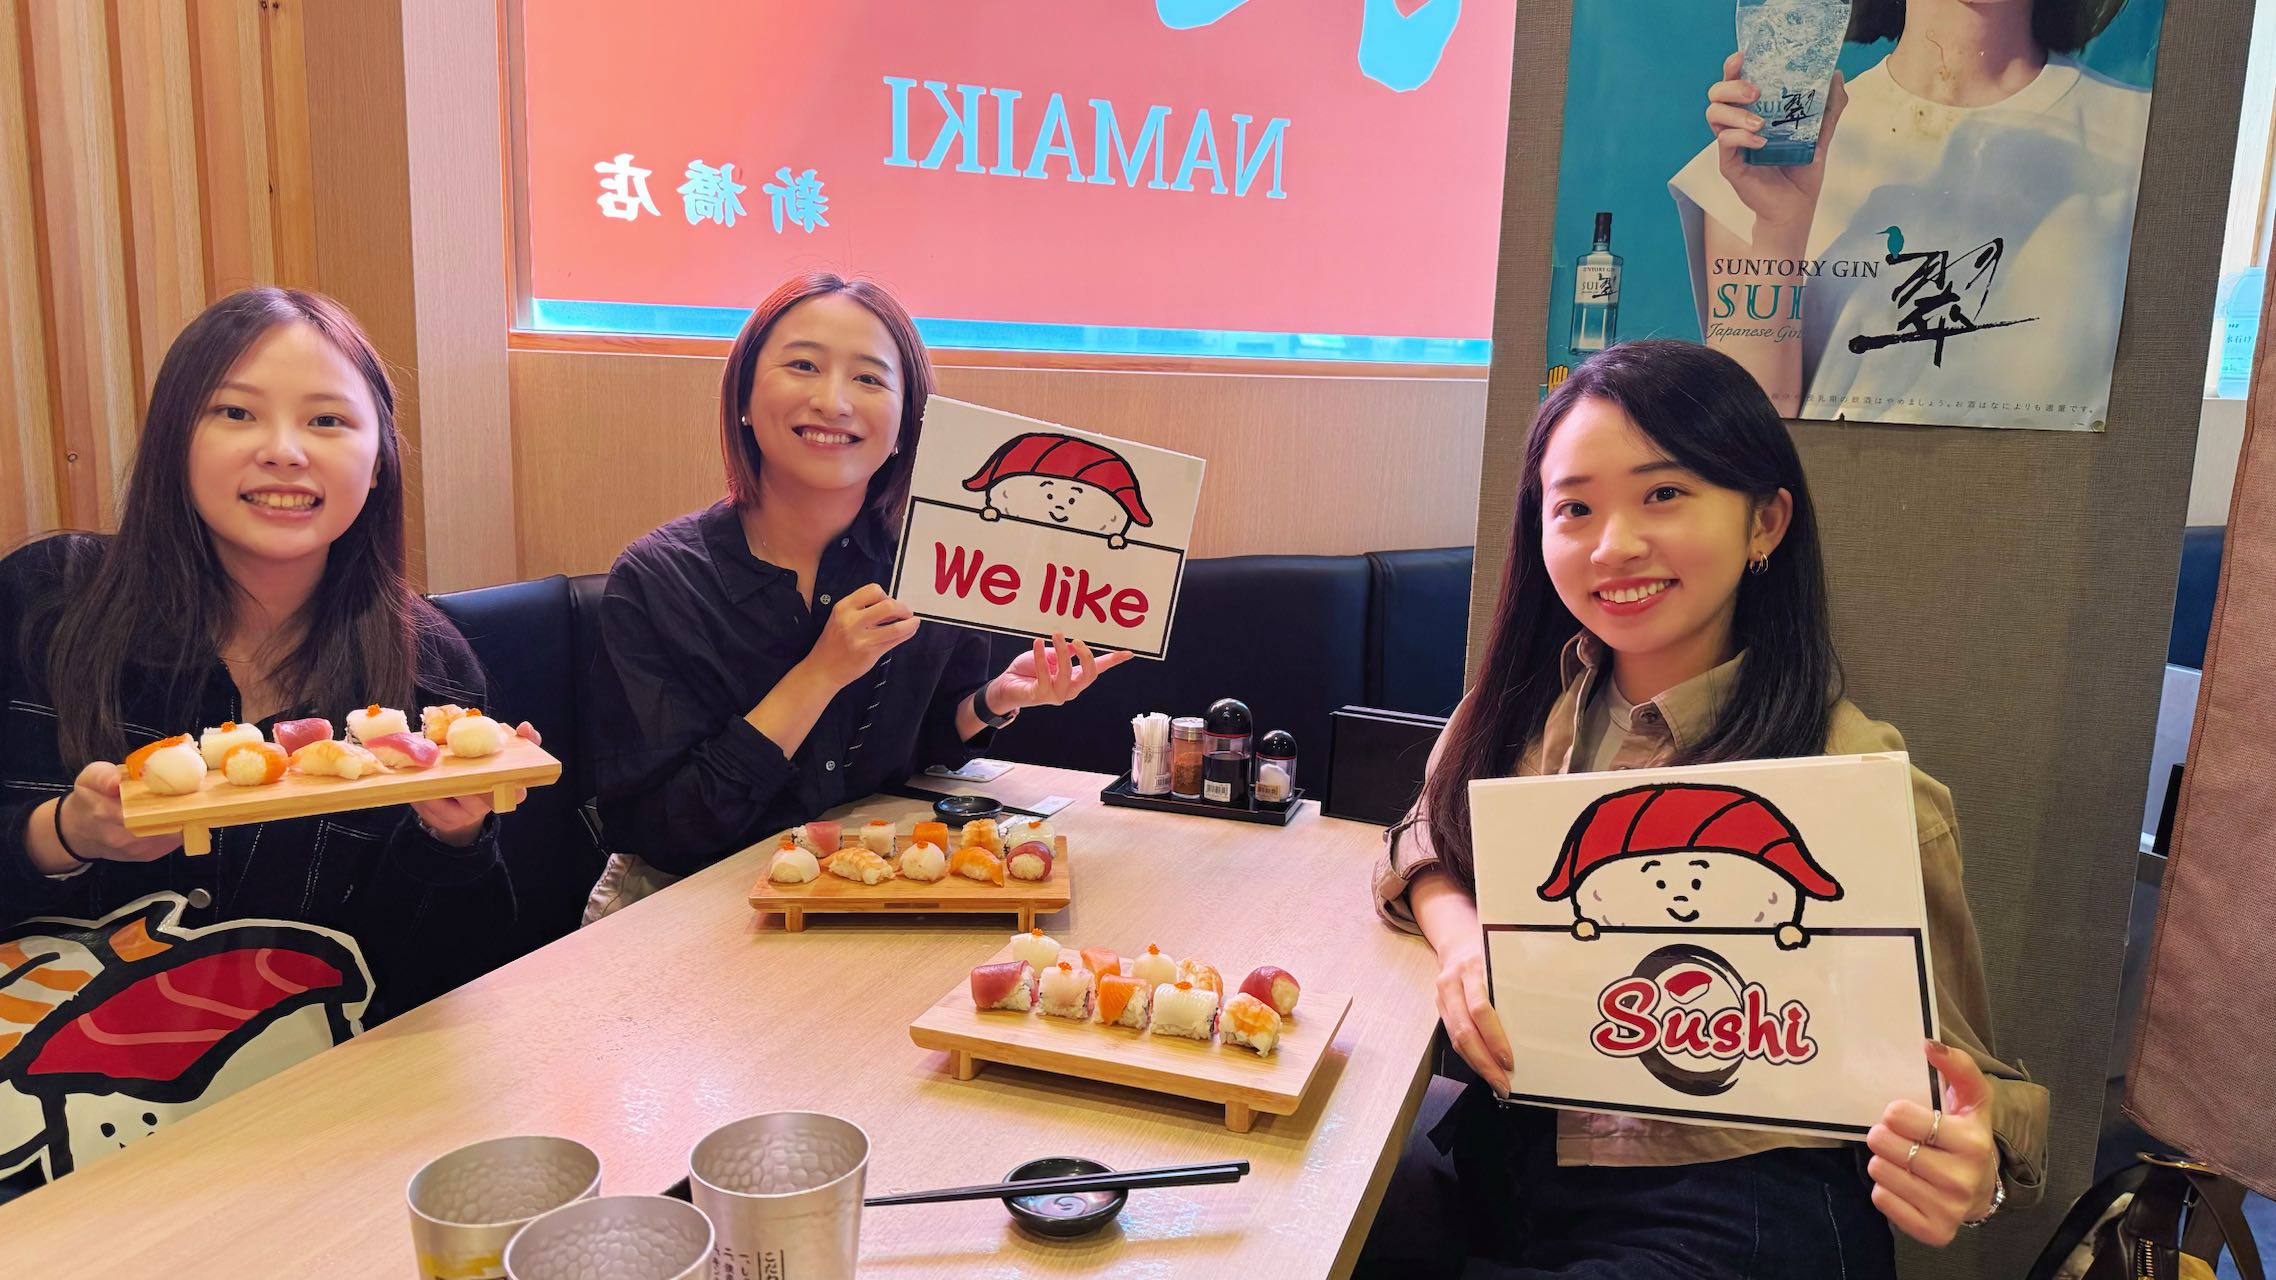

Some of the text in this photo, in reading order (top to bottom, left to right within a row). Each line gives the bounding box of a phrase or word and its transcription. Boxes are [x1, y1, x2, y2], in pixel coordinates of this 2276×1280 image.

[1755, 100, 1780, 113] SUI
[1712, 258, 1879, 278] SUNTORY GIN
[1582, 281, 1599, 290] SUI
[1713, 283, 1808, 320] SUI
[1706, 323, 1803, 342] Japanese Gin
[934, 541, 1149, 628] We like
[1594, 979, 1813, 1060] Sushi
